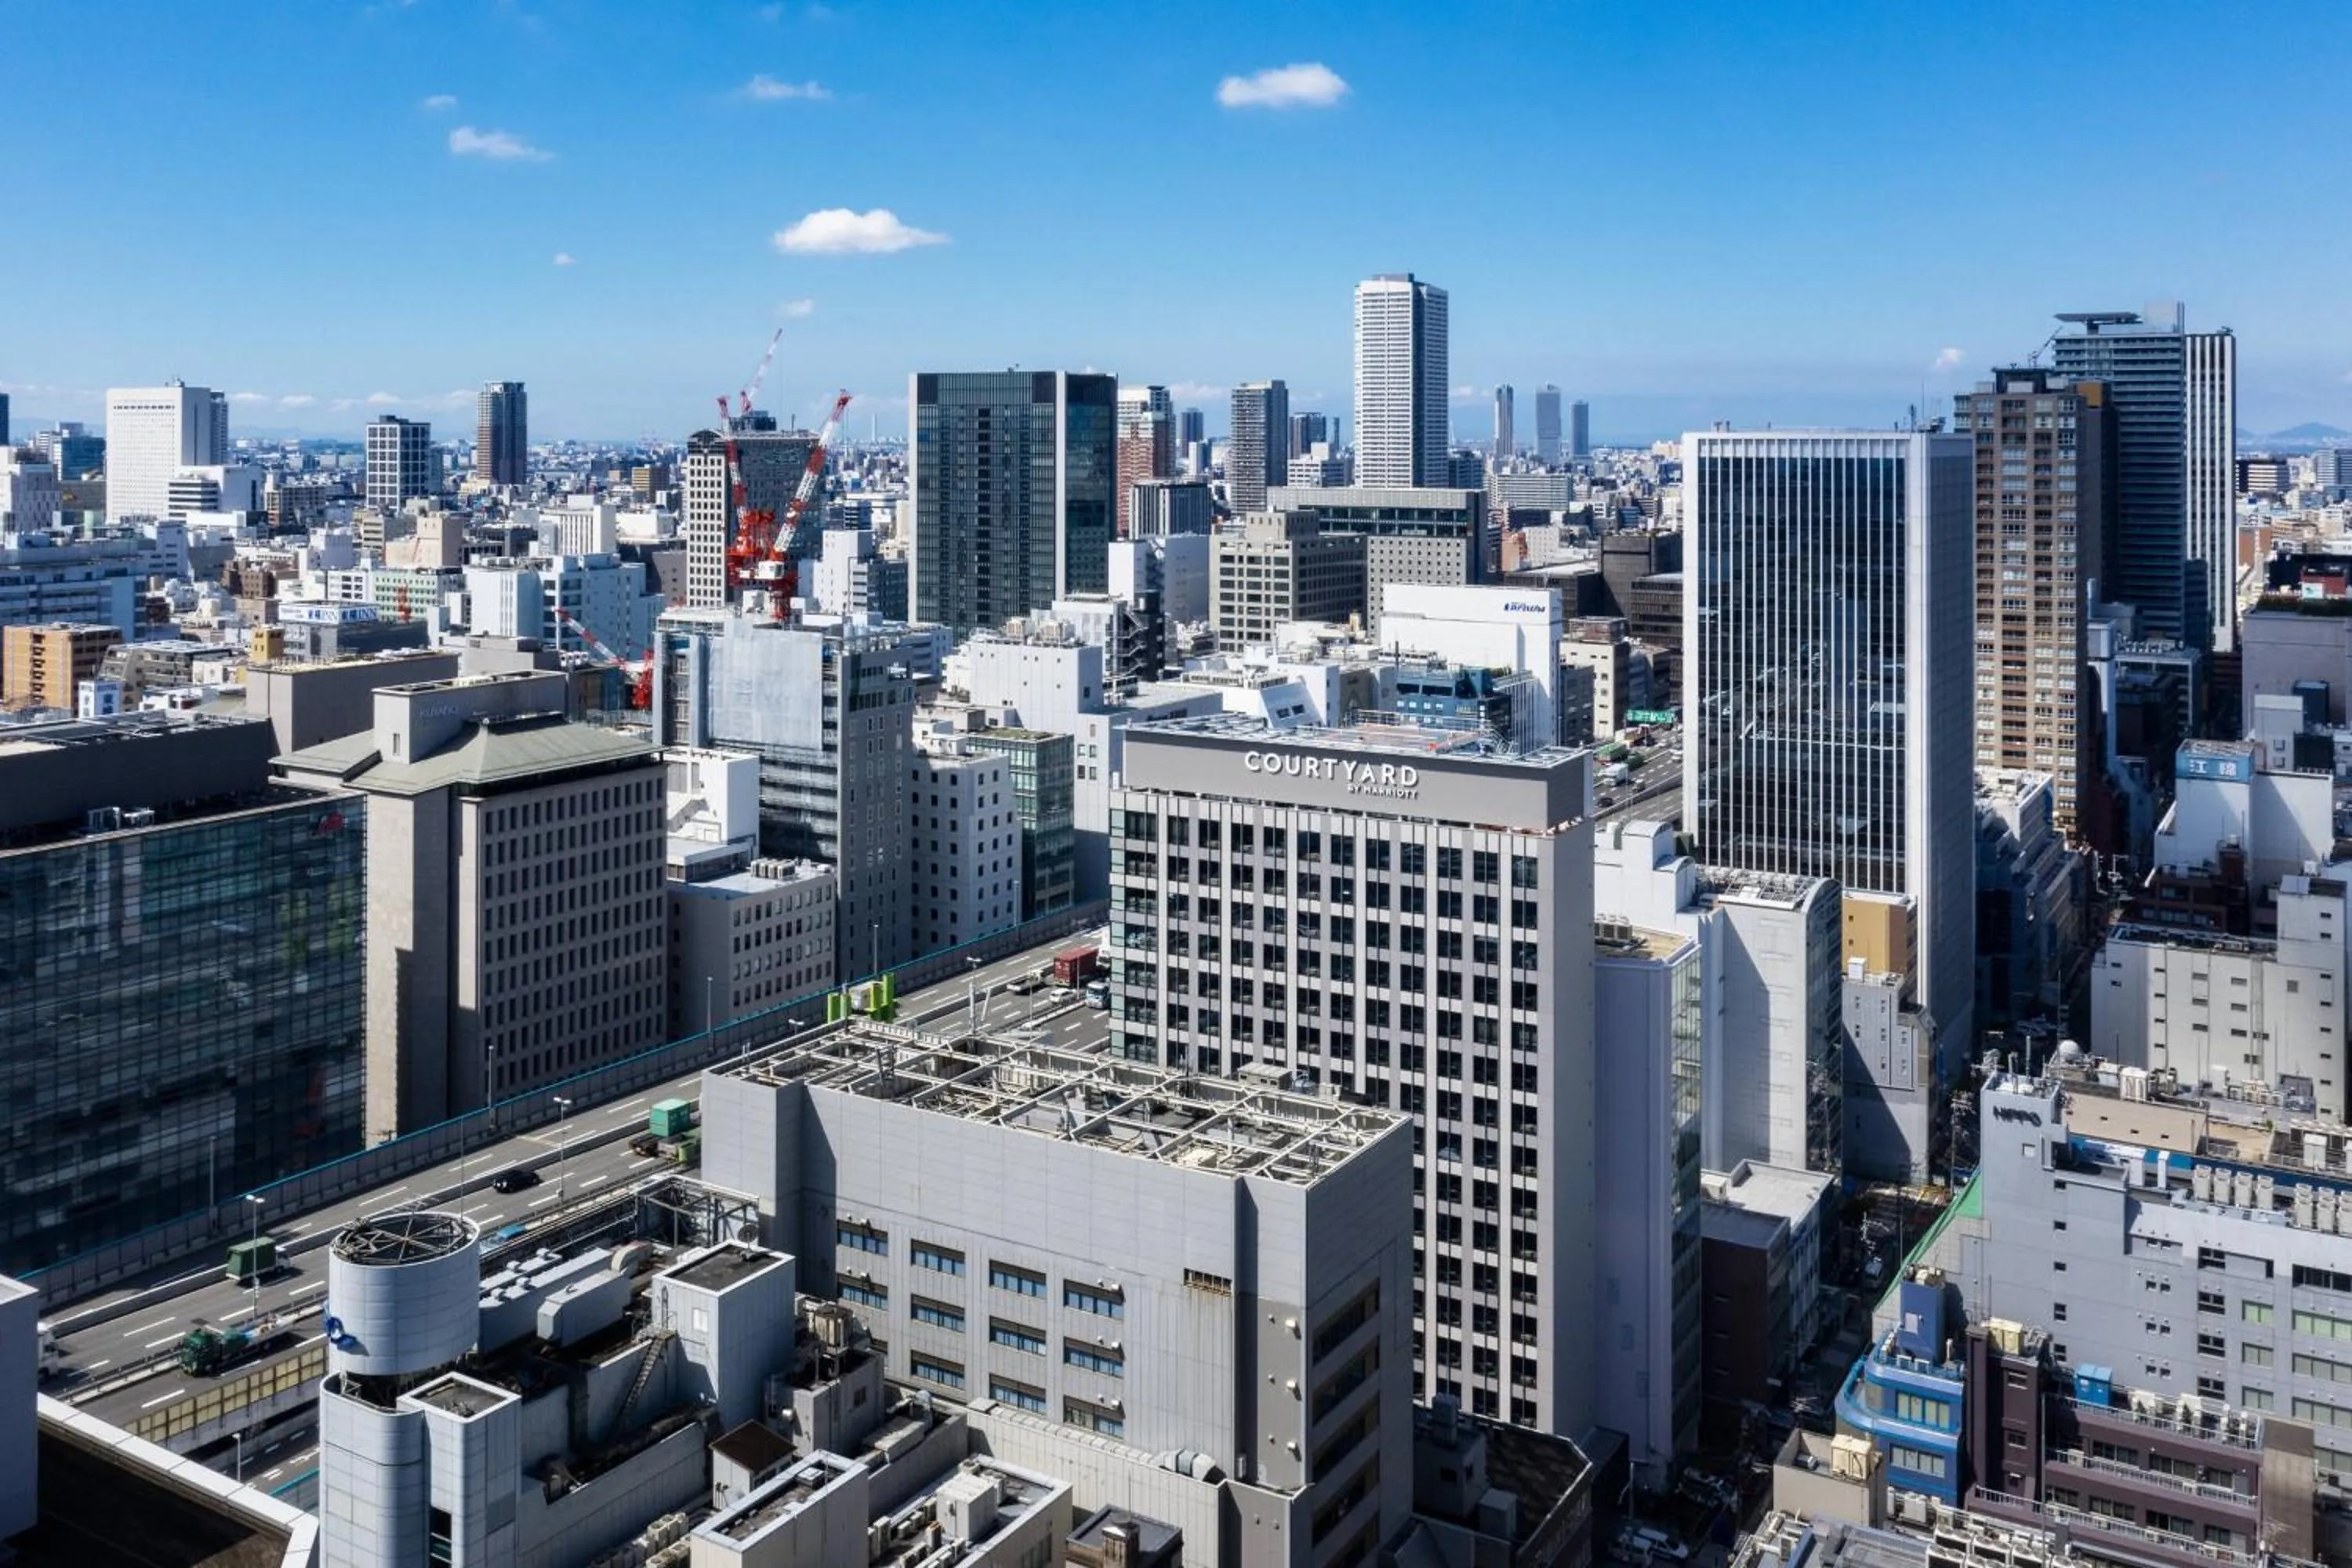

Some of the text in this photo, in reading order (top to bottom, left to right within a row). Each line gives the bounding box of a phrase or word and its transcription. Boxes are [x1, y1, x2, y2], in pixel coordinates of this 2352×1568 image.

[1244, 750, 1417, 786] COURTYARD
[1348, 784, 1417, 798] BY MARRIOTT
